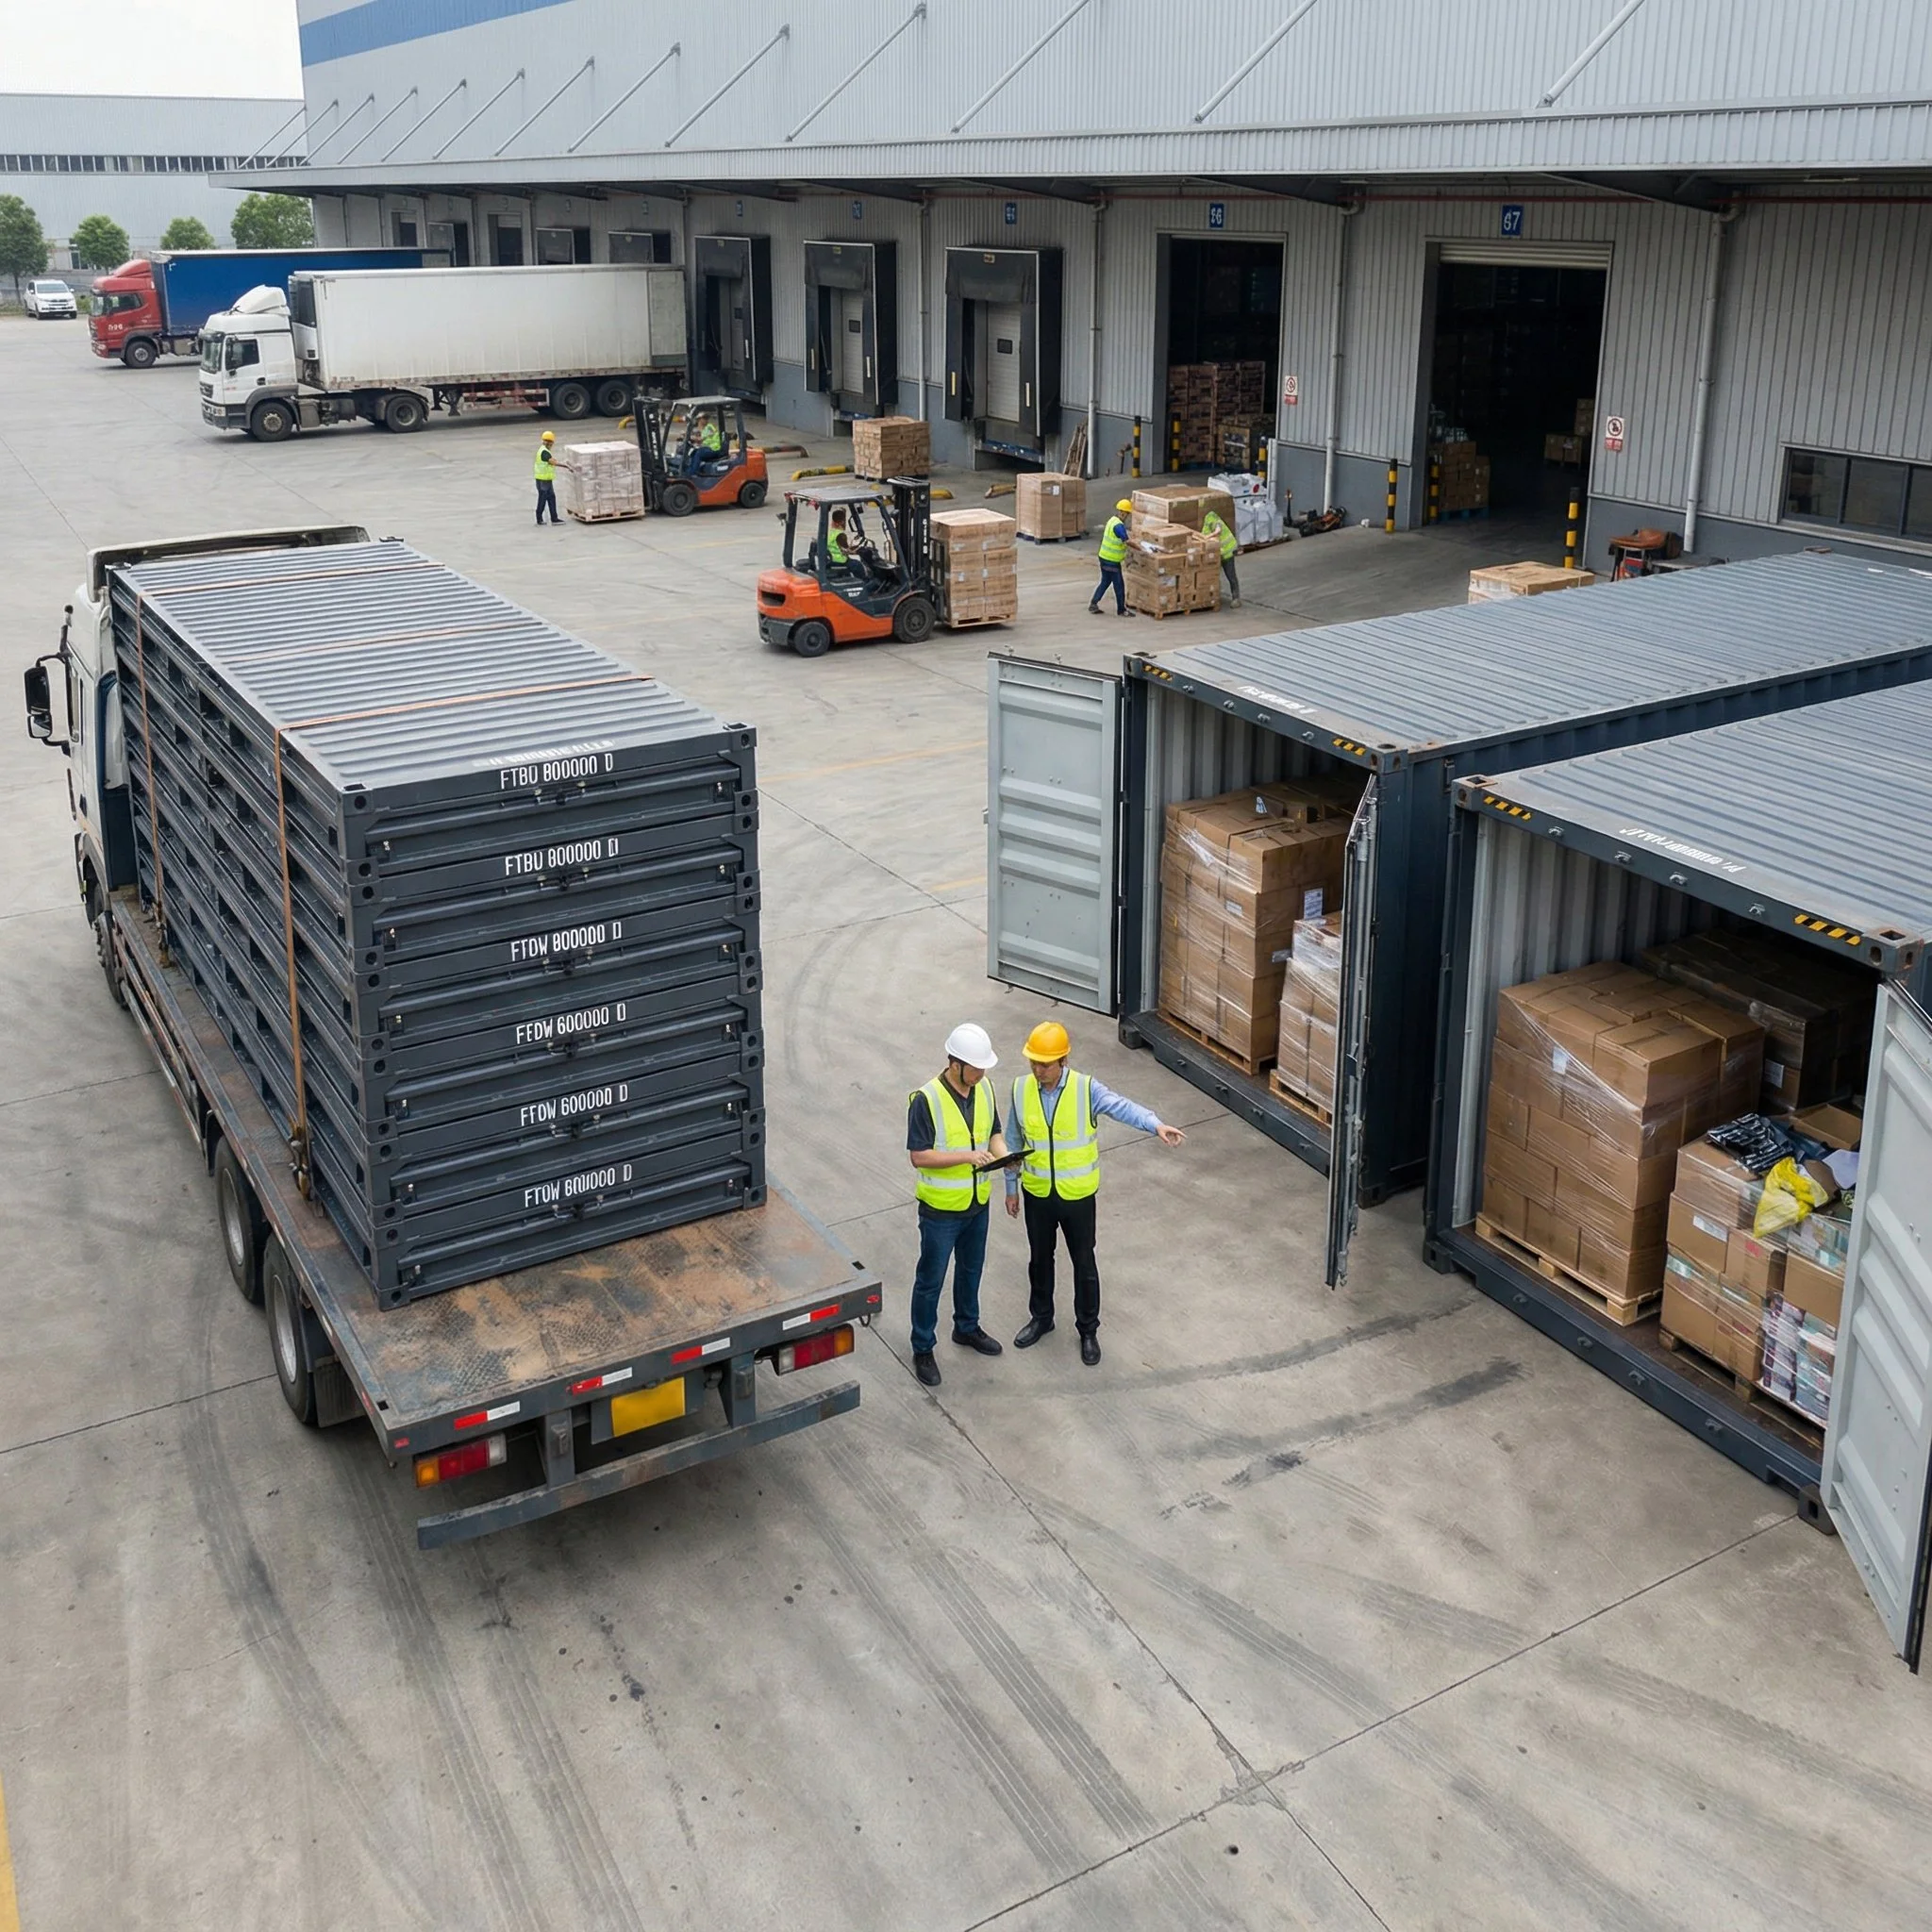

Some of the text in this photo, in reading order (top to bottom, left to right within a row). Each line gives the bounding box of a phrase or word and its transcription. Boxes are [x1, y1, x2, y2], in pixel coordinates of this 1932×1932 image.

[605, 753, 614, 772] D
[557, 1007, 609, 1035] 600000
[560, 1088, 612, 1116] 600000
[619, 1084, 628, 1103] D
[623, 1163, 633, 1182] D
